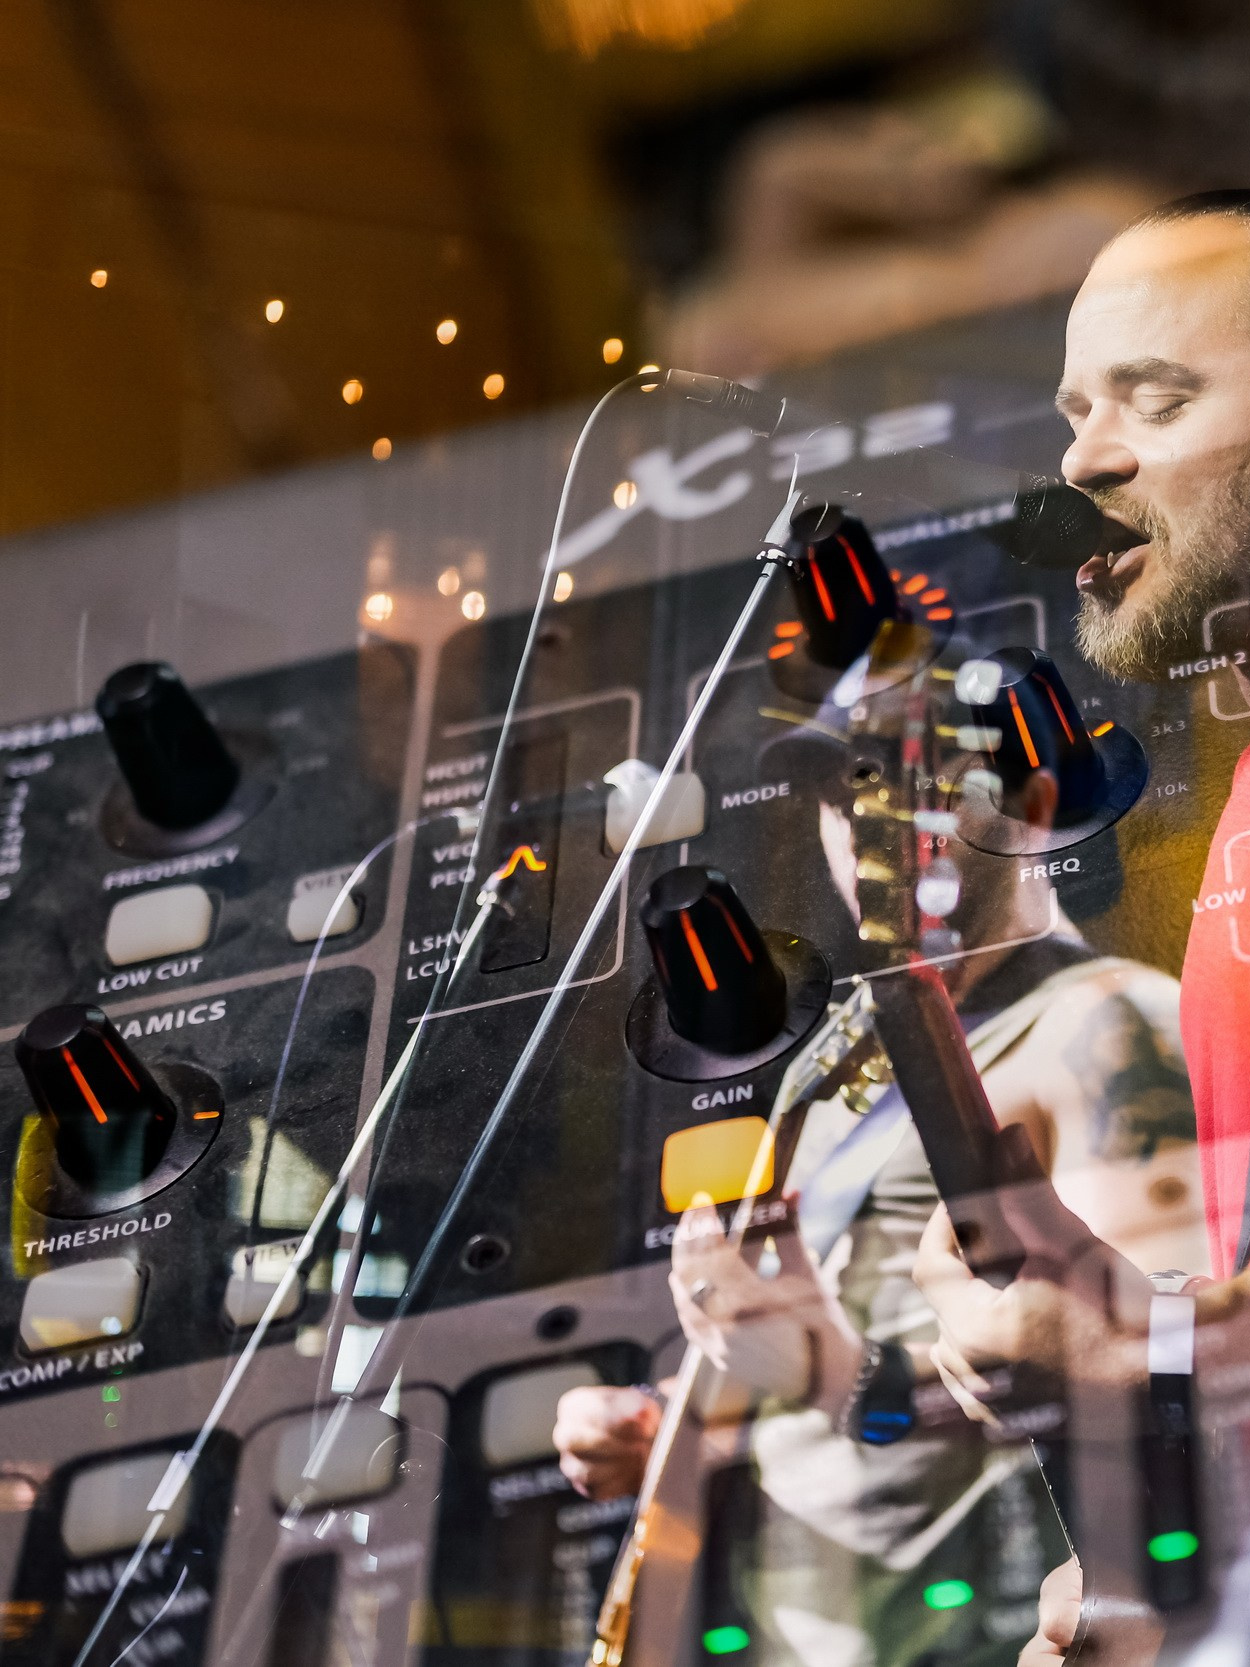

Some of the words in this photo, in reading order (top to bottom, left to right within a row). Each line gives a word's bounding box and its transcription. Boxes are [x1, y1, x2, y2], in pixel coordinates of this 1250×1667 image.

[1168, 655, 1227, 681] HIGH
[1230, 652, 1248, 666] 2
[1151, 720, 1187, 738] 3k3
[721, 782, 791, 810] MODE
[915, 774, 948, 792] 120
[1155, 782, 1189, 799] 10k
[923, 836, 948, 850] 40
[102, 845, 240, 890] FREQUENCY
[430, 864, 477, 890] PEQ
[1019, 857, 1081, 883] FREQ
[1191, 886, 1247, 914] LOW
[408, 928, 468, 957] LSHV
[97, 970, 151, 994] LOW
[154, 956, 204, 982] CUT
[406, 956, 463, 982] LCU
[114, 999, 228, 1040] AMICS
[691, 1083, 754, 1111] GAIN
[24, 1212, 173, 1257] THRESHOLD
[94, 1341, 145, 1369] EXP
